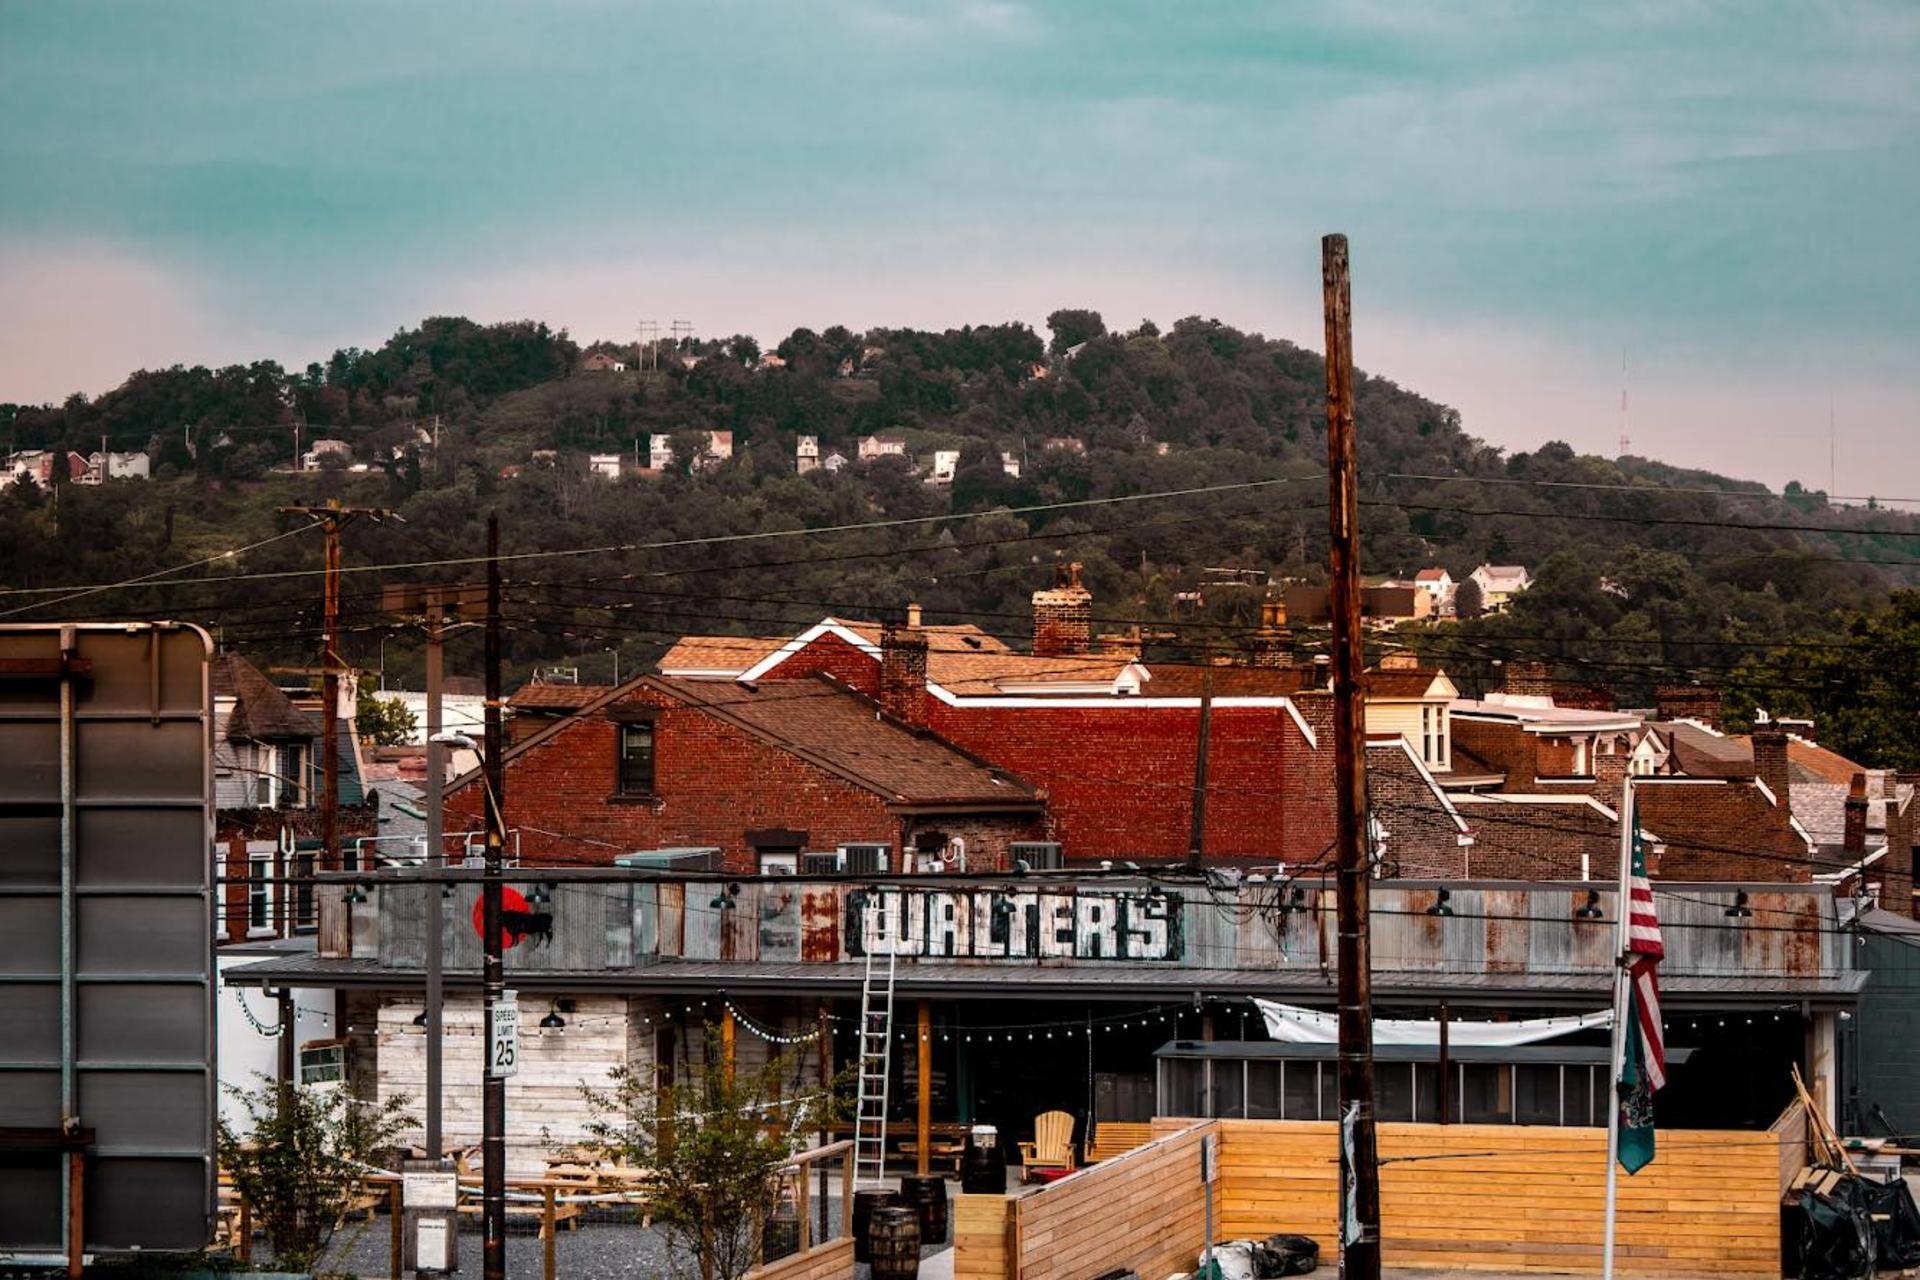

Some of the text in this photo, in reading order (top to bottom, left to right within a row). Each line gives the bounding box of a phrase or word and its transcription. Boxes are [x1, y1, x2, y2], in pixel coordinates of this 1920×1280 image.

[495, 1009, 516, 1022] SPEED
[497, 1025, 514, 1037] LIMIT
[496, 1040, 515, 1067] 25
